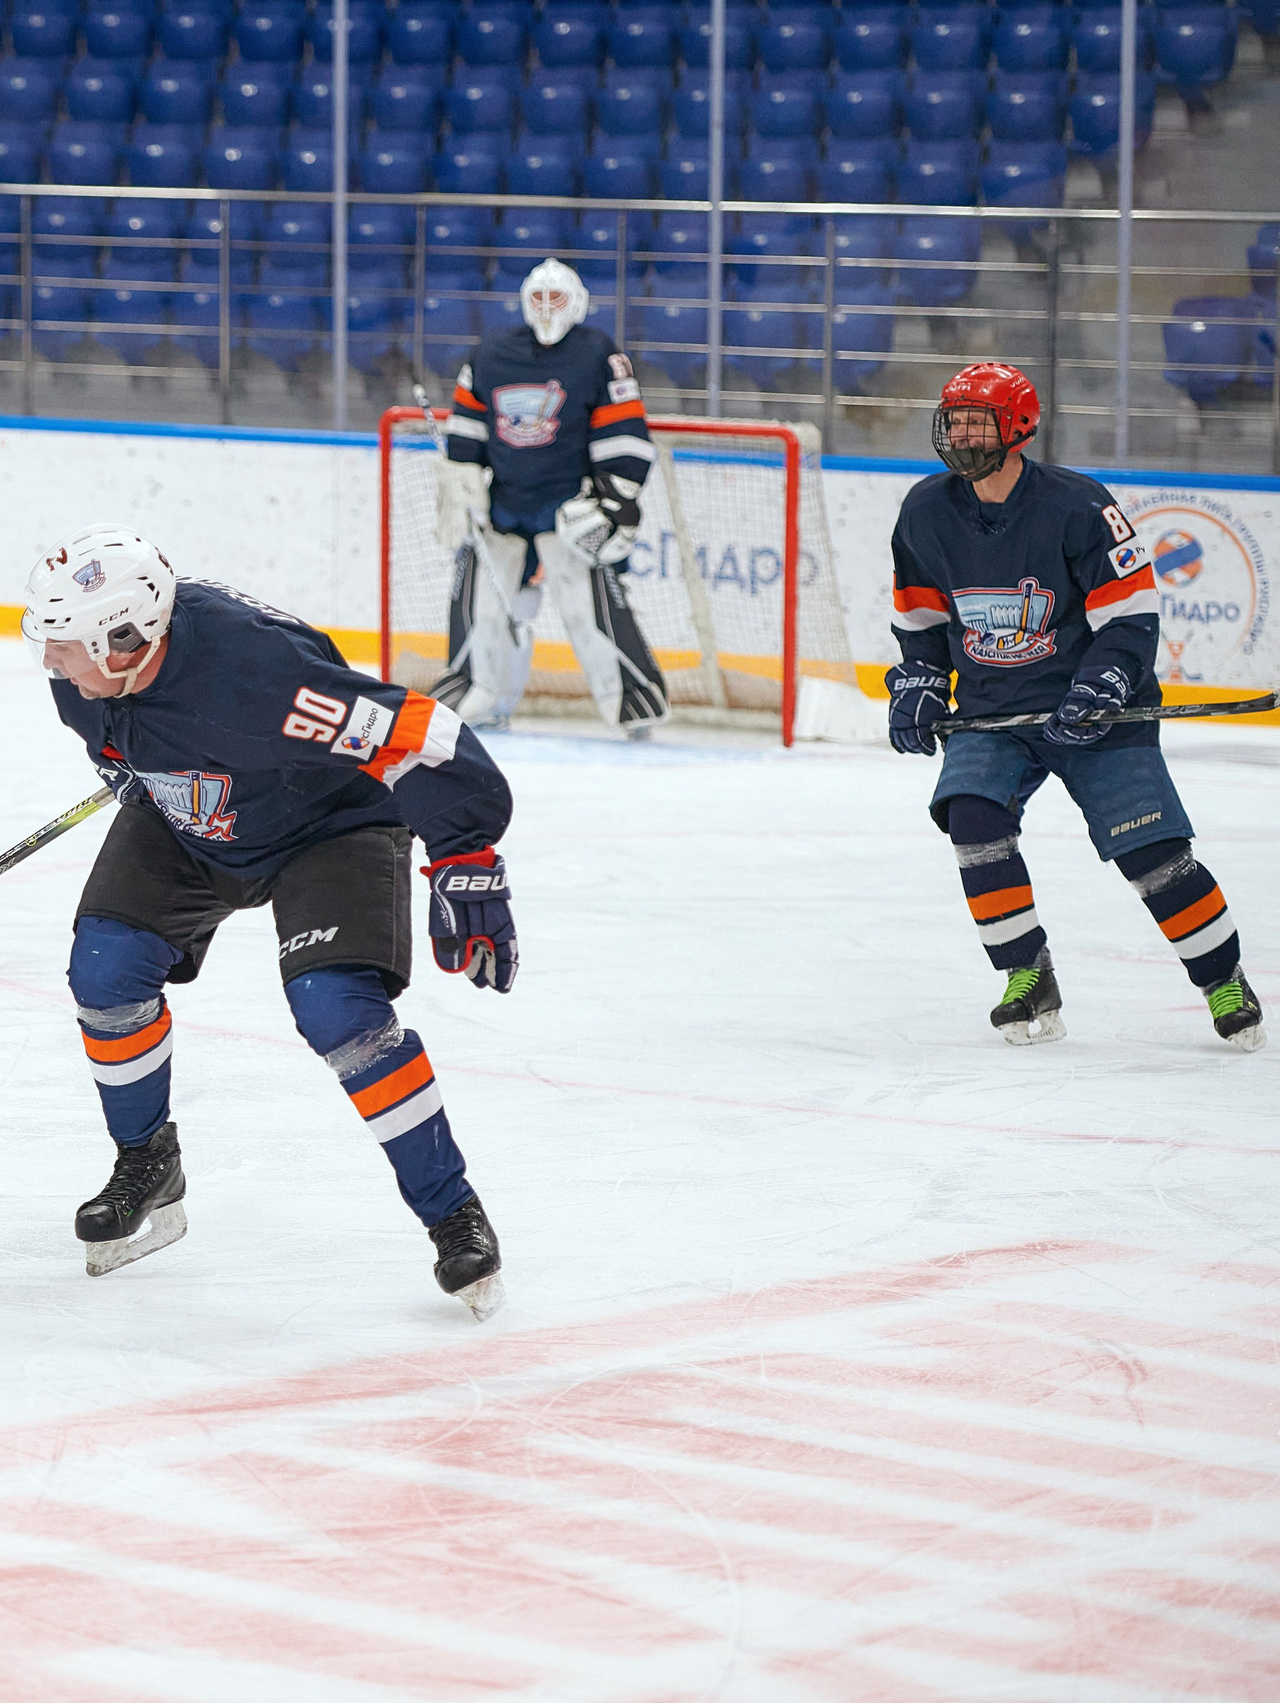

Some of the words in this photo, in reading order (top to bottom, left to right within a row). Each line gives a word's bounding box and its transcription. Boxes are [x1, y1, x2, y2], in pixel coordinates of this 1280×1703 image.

[1101, 504, 1133, 543] 8
[98, 607, 130, 626] CCM
[894, 676, 948, 691] BAUE
[282, 686, 348, 743] 90
[278, 926, 339, 960] CCM
